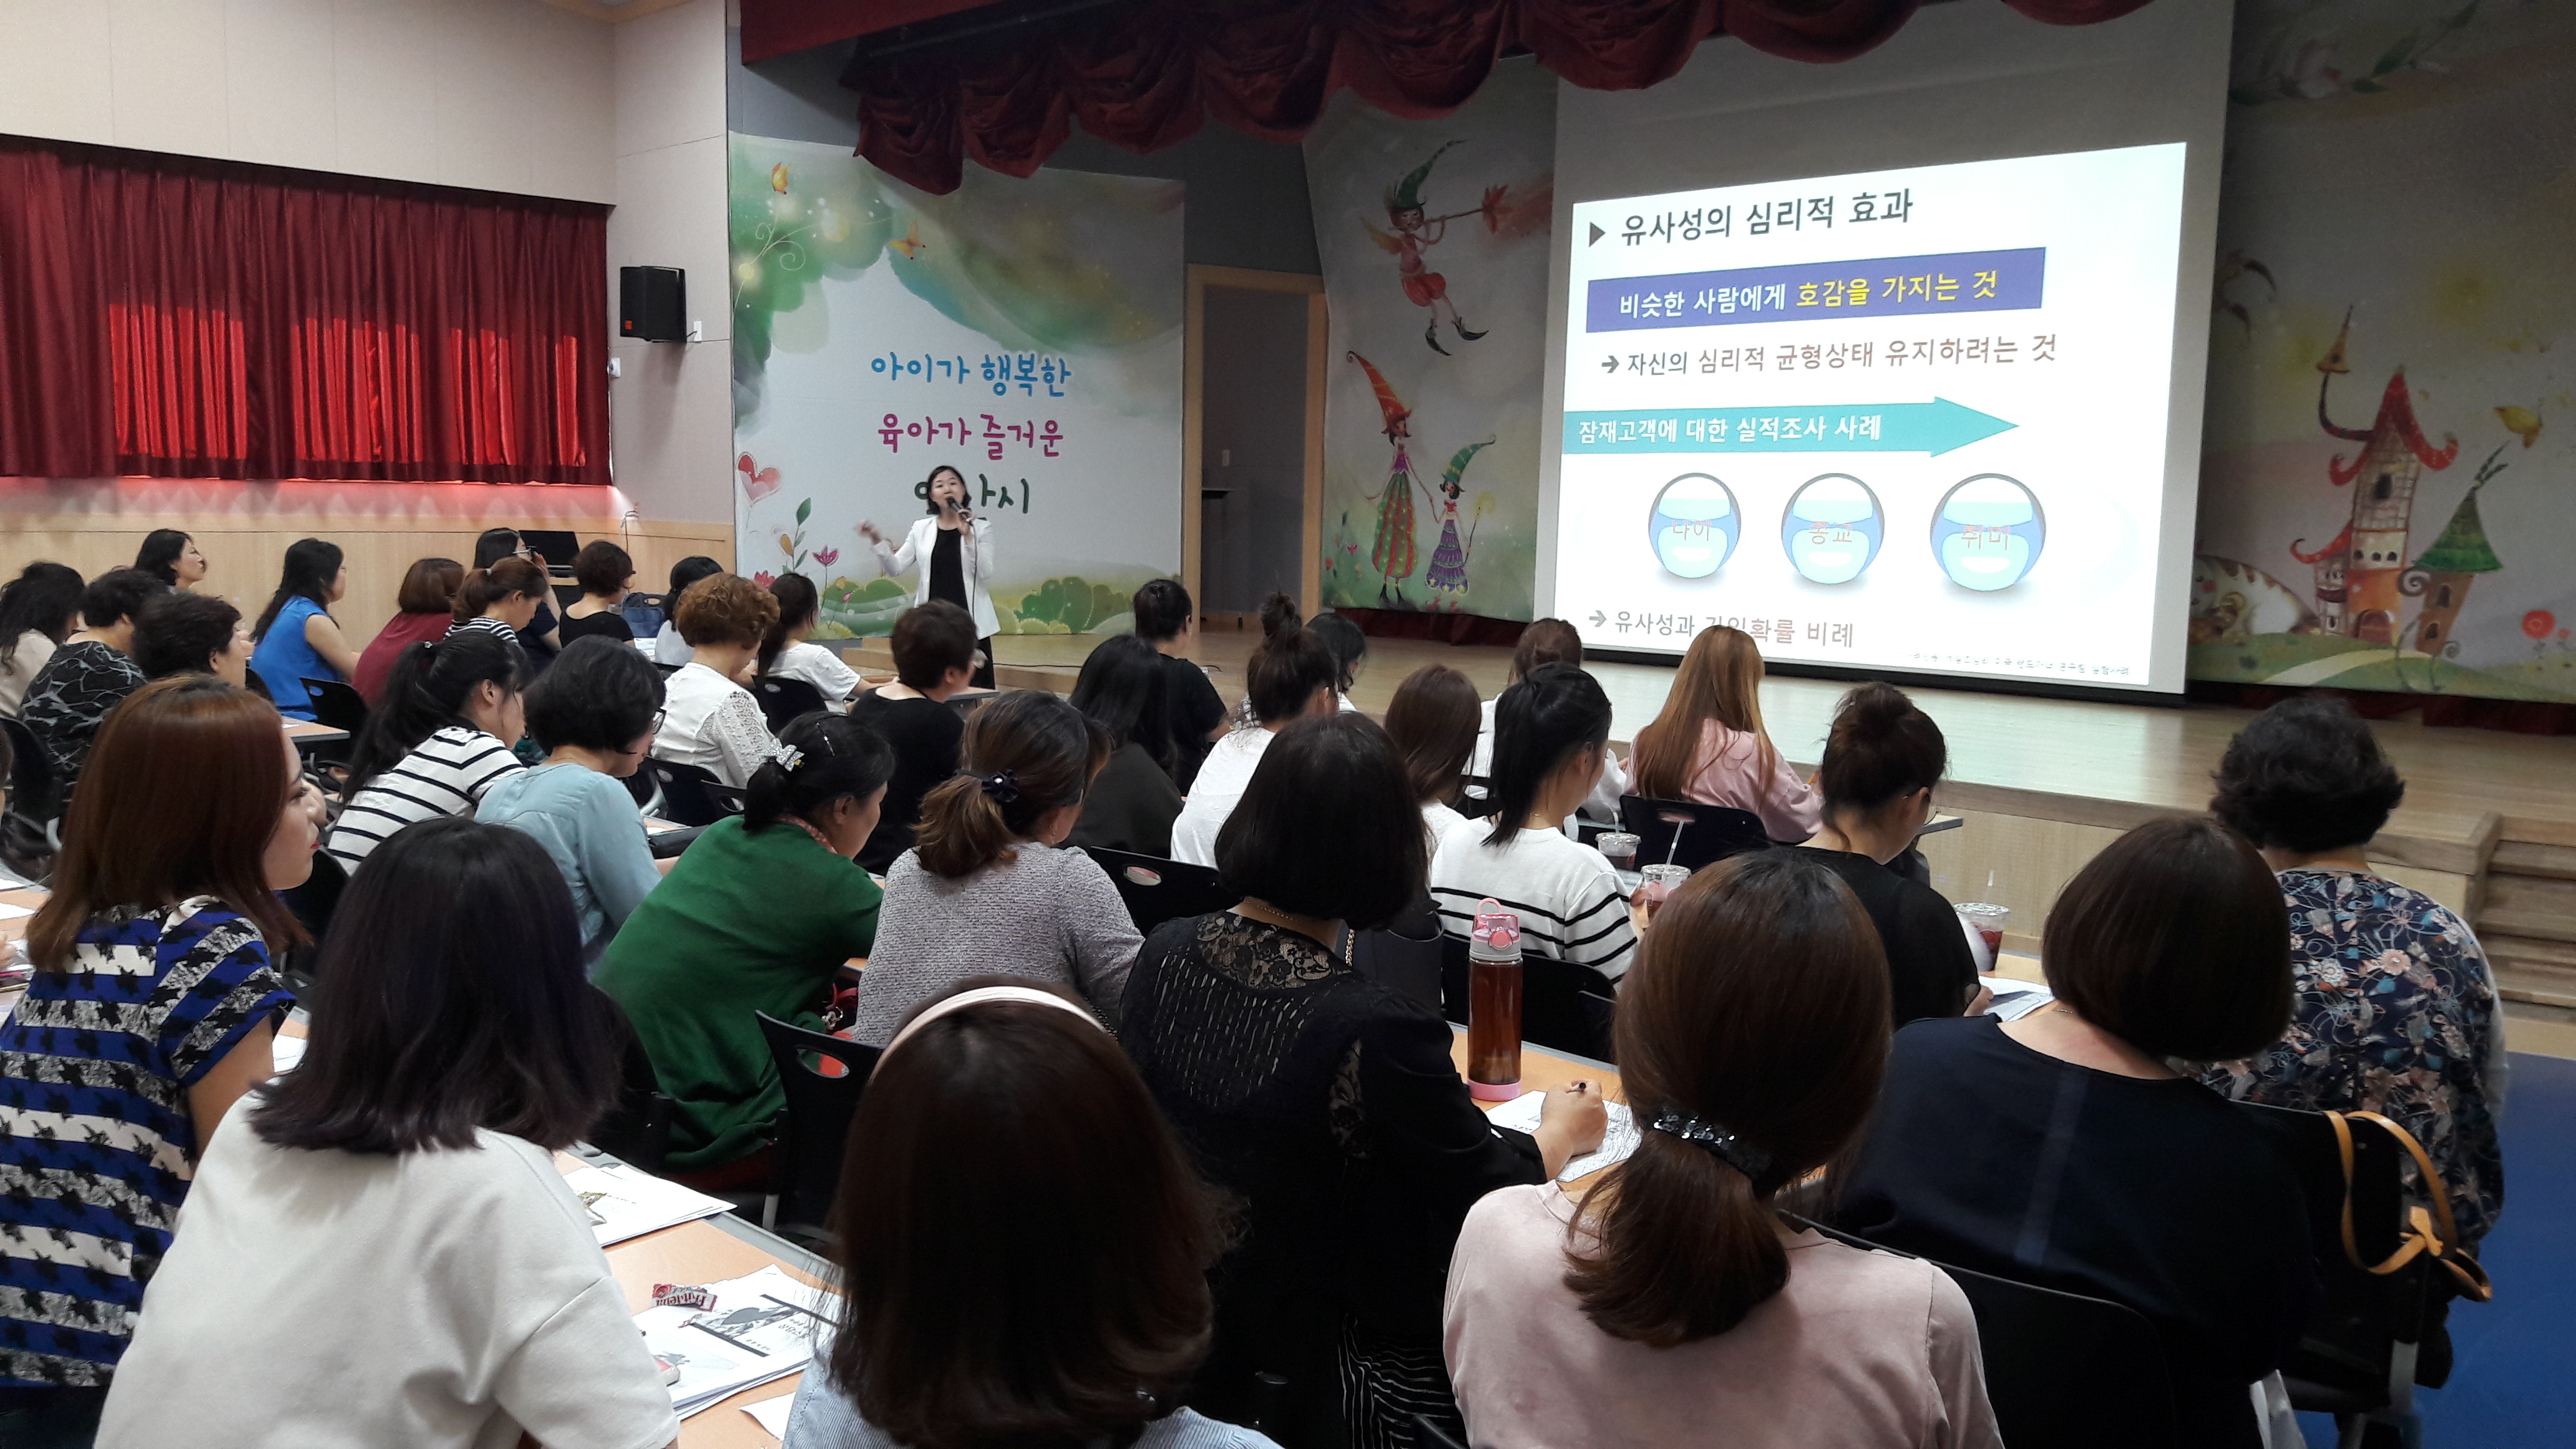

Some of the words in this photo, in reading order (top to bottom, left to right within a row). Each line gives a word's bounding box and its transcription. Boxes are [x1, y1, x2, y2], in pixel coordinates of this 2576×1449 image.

[1621, 205, 1731, 246] 유사성의
[1746, 196, 1834, 235] 심리적
[1848, 188, 1913, 223] 효과
[1619, 291, 1686, 319] 비슷한
[1693, 284, 1786, 315] 사람에게
[1795, 279, 1871, 308] 호감을
[1881, 273, 1959, 303] 가지는
[1972, 270, 1998, 299] 것
[871, 351, 970, 384] 아이가
[980, 353, 1072, 397] 행복한
[1627, 351, 1687, 376] 자신의
[1698, 346, 1764, 374] 심리적
[1777, 341, 1873, 369] 균형상태
[1885, 336, 2018, 367] 유지하려는
[2032, 334, 2057, 363] 것
[878, 413, 972, 453] 육아가
[980, 414, 1063, 461] 즐거운
[1579, 419, 1677, 444] 잠재고객에
[1686, 418, 1727, 443] 대한
[1737, 416, 1826, 442] 실적조사
[1834, 414, 1881, 441] 사례
[1672, 519, 1711, 541] 나이
[1809, 520, 1853, 545] 종교
[1961, 524, 2011, 550] 취미
[1615, 611, 1695, 637] 유사성과
[1807, 622, 1853, 648] 비례
